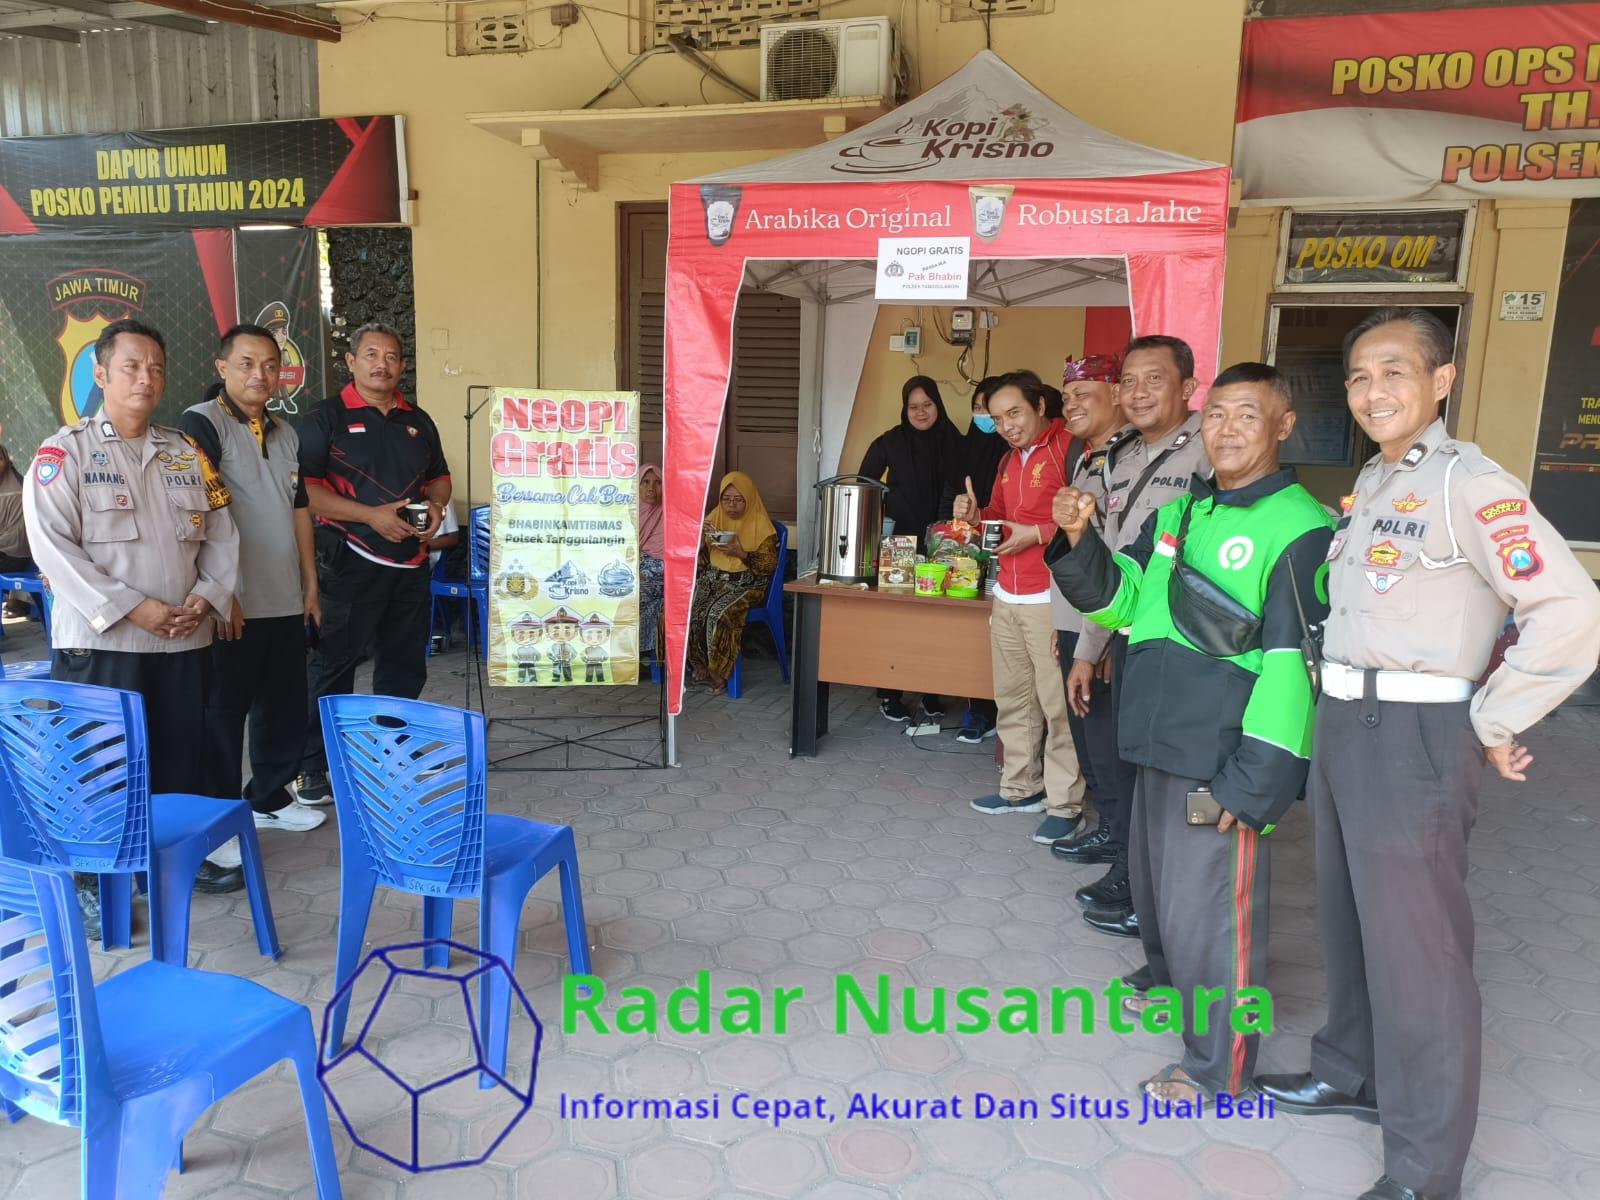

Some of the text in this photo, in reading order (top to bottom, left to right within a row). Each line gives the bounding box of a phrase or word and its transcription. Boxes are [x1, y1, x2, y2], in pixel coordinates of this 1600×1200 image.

[1330, 51, 1475, 96] POSKO
[1483, 45, 1577, 88] OPS
[921, 117, 998, 141] Kopi
[920, 138, 1055, 159] Krisno
[96, 143, 228, 180] DAPUR UMUM
[30, 177, 306, 217] POSKO PEMILU TAHUN 2024
[744, 205, 952, 233] Arabika Original
[1018, 200, 1202, 225] Robusta Jahe
[896, 246, 964, 255] NGOPI GRATIS
[1295, 235, 1387, 270] POSKO
[908, 271, 962, 281] Pak Bhabin
[54, 277, 140, 302] JAWA TIMUR
[1520, 293, 1542, 305] 15
[501, 396, 629, 432] NGOPI
[491, 433, 638, 478] Gratis
[85, 472, 125, 485] NANANG
[166, 475, 202, 487] POLRI
[1151, 477, 1189, 489] POLRI
[496, 483, 633, 506] Bersama Cak Ben
[508, 519, 622, 531] BHABINKAMTIBMAS
[1372, 519, 1426, 538] POLRI
[505, 534, 625, 547] Polsek Tanggulangin
